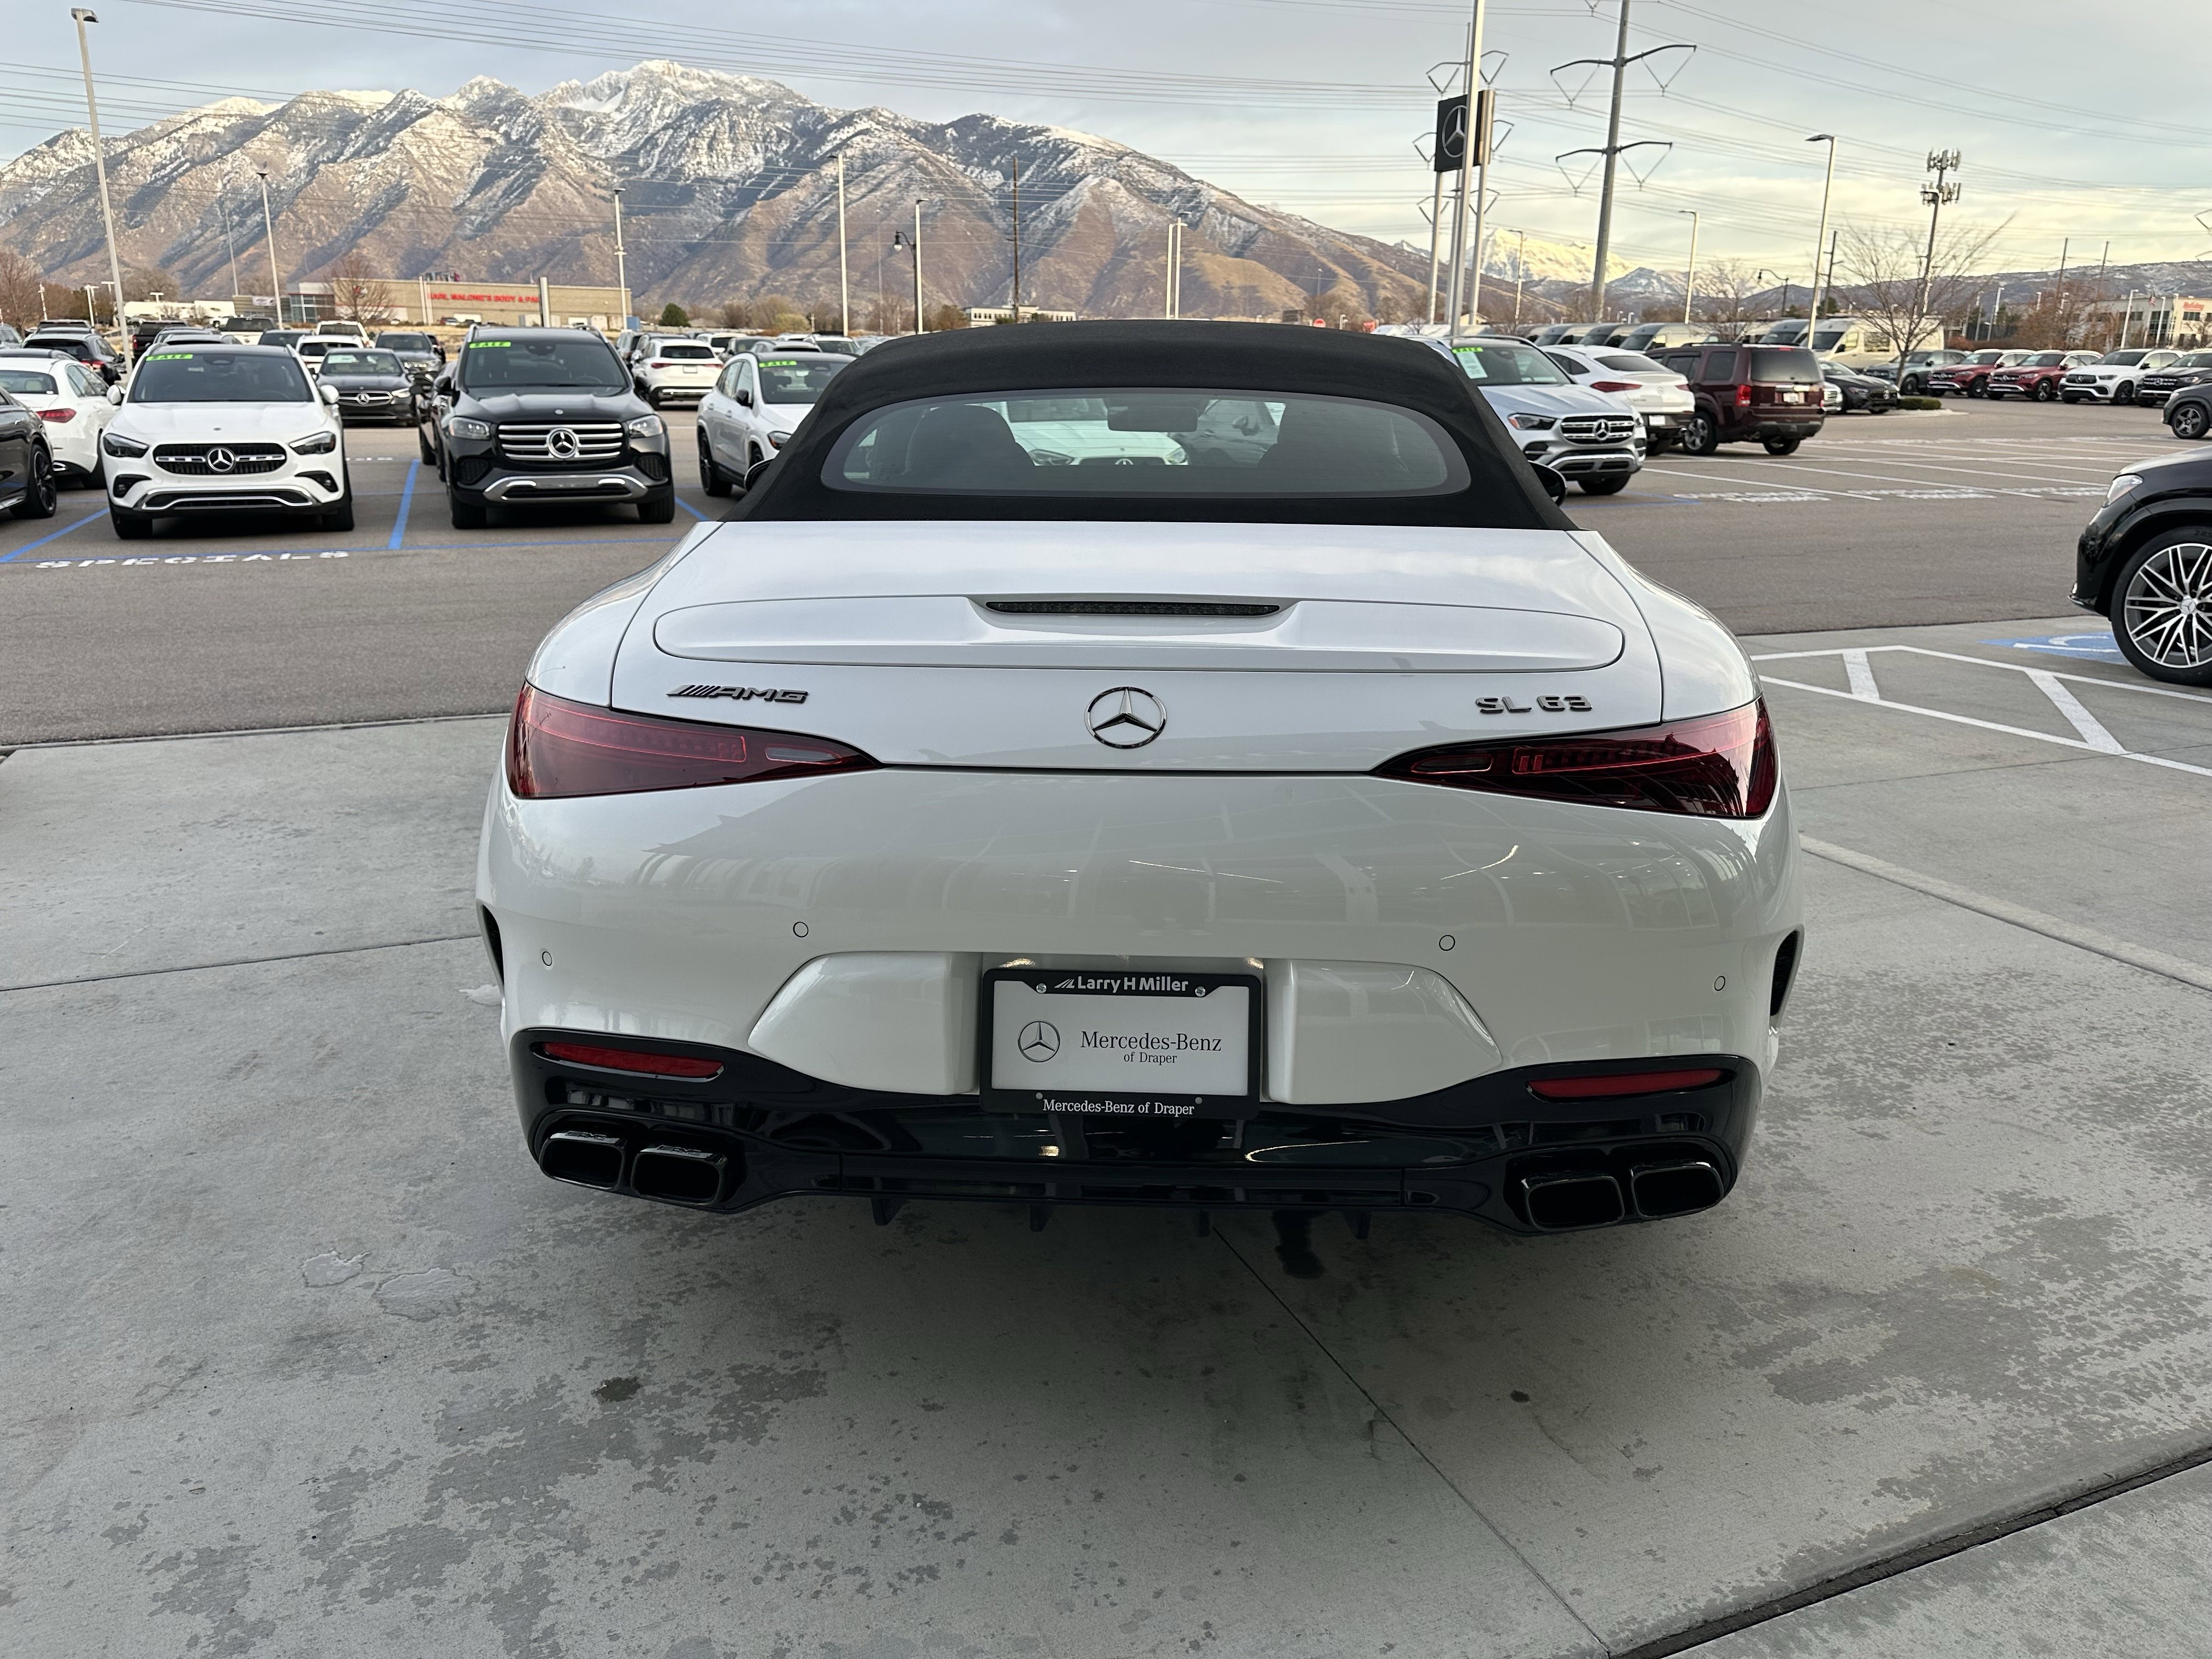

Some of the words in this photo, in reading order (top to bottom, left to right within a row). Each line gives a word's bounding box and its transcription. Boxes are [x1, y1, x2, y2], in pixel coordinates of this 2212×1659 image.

[708, 686, 809, 703] AMG
[1475, 696, 1532, 714] SL
[1536, 695, 1594, 712] 63
[1077, 976, 1121, 993] Larry
[1124, 977, 1136, 990] H
[1139, 976, 1189, 991] Miller
[1080, 1031, 1222, 1051] Mercedes-Benz
[1124, 1052, 1135, 1062] of
[1139, 1052, 1177, 1065] Draper
[1042, 1099, 1135, 1113] Mercedes-Benz
[1138, 1102, 1150, 1113] of
[1154, 1102, 1195, 1117] Draper
